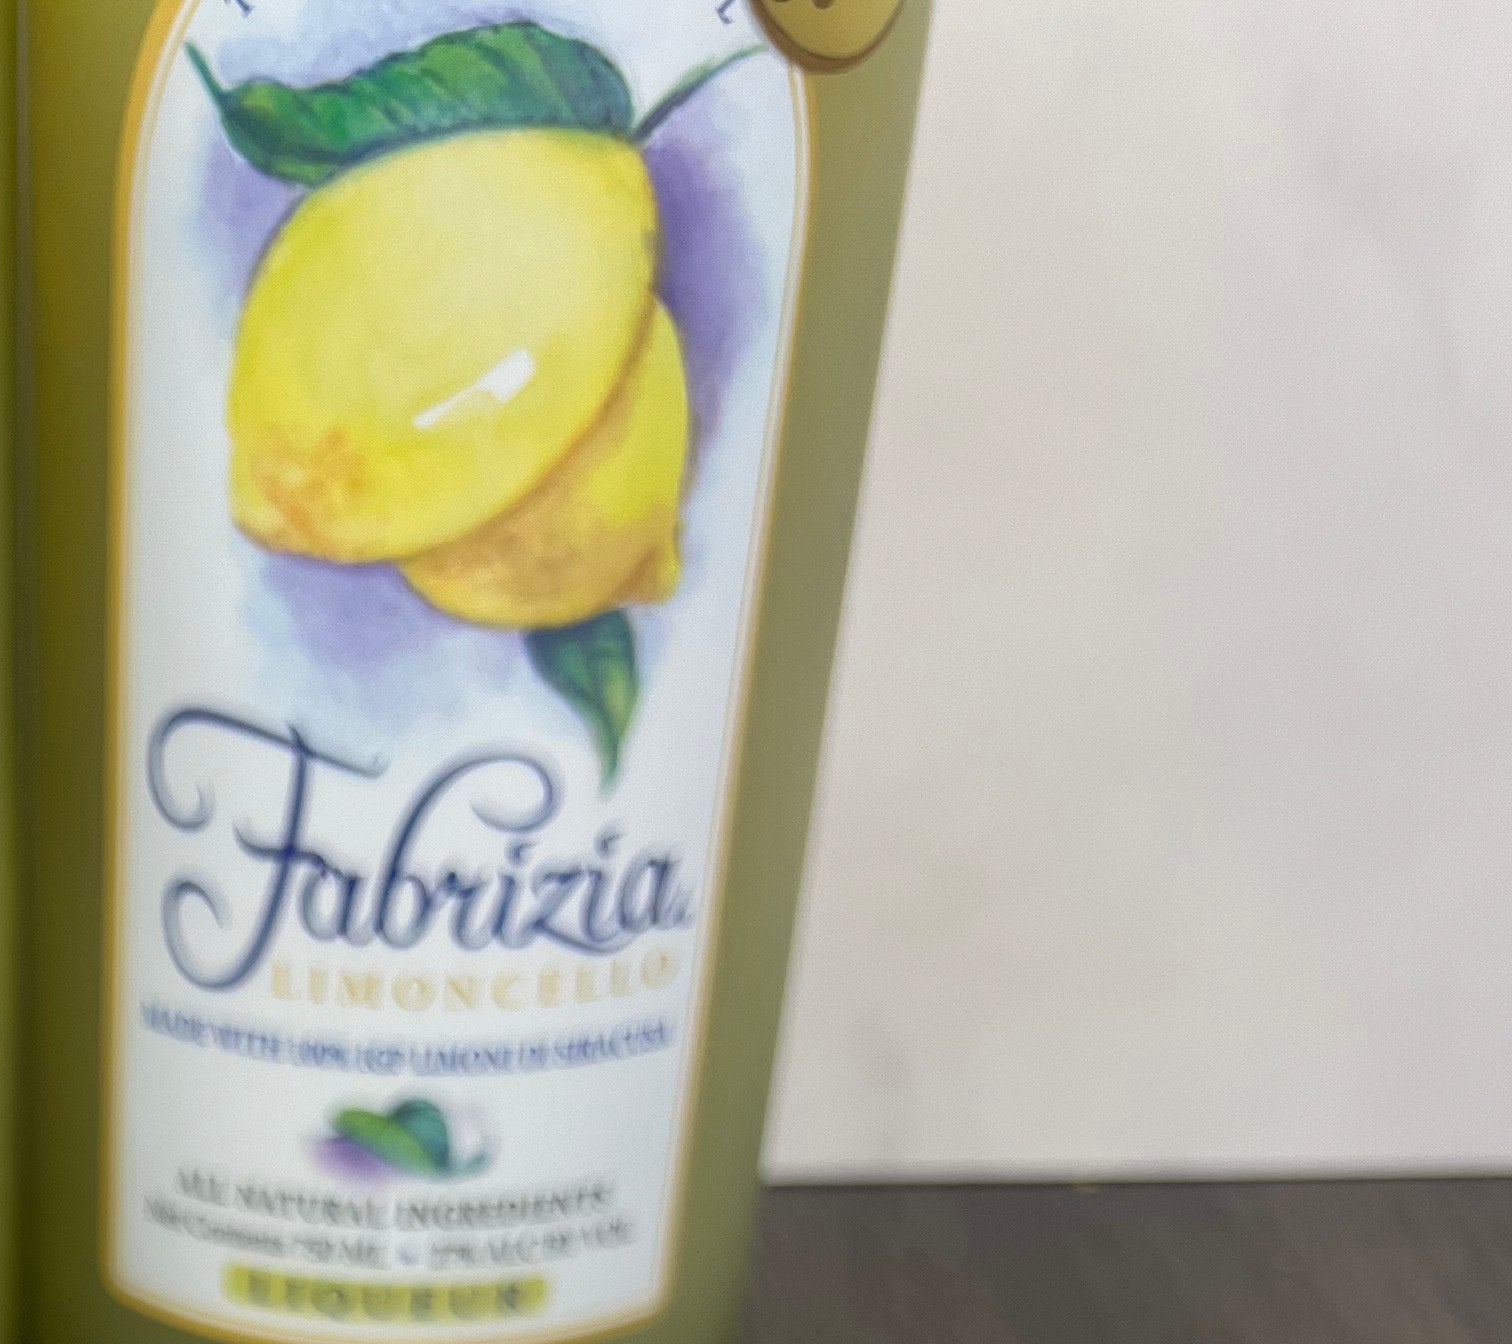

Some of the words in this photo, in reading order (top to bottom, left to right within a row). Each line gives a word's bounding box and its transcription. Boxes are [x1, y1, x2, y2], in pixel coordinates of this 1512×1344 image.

[147, 707, 676, 993] Fabrizia
[269, 945, 679, 1011] LIMONCELLO
[178, 1168, 229, 1207] ALL
[236, 1183, 389, 1229] NATURAL
[394, 1180, 616, 1231] INGREDIENTS
[246, 1267, 523, 1322] LIQUEUR
